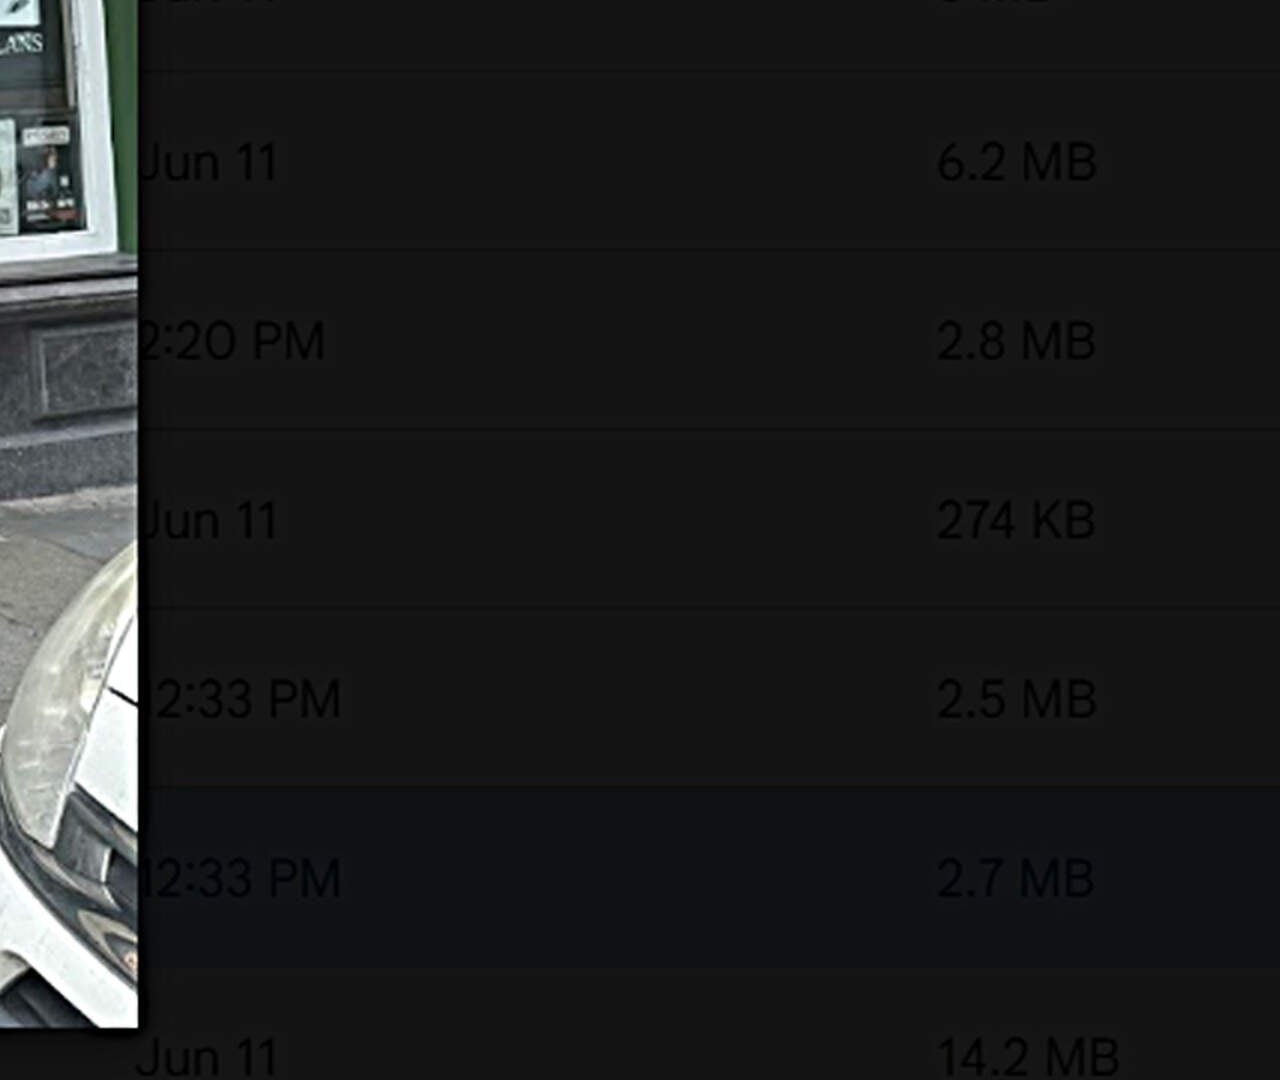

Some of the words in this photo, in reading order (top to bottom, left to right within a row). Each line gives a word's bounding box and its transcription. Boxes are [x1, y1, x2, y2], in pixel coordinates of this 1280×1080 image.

[141, 141, 218, 180] Jun
[238, 142, 273, 180] 11
[939, 141, 1005, 181] 6.2
[1024, 142, 1096, 180] MB
[256, 320, 323, 360] PM
[938, 320, 1004, 360] 2.8
[1024, 320, 1095, 360] MB
[238, 501, 273, 539] 11
[938, 499, 1015, 539] 274
[1034, 500, 1094, 539] KB
[271, 678, 339, 718] PM
[939, 678, 1005, 718] 2.5
[1024, 679, 1096, 718] MB
[271, 858, 339, 897] PM
[938, 857, 1003, 897] 2.7
[1021, 858, 1093, 897] MB
[135, 1037, 218, 1076] Jun
[238, 1037, 274, 1076] 11
[940, 1037, 1028, 1076] 14.2
[1048, 1037, 1119, 1076] MB
